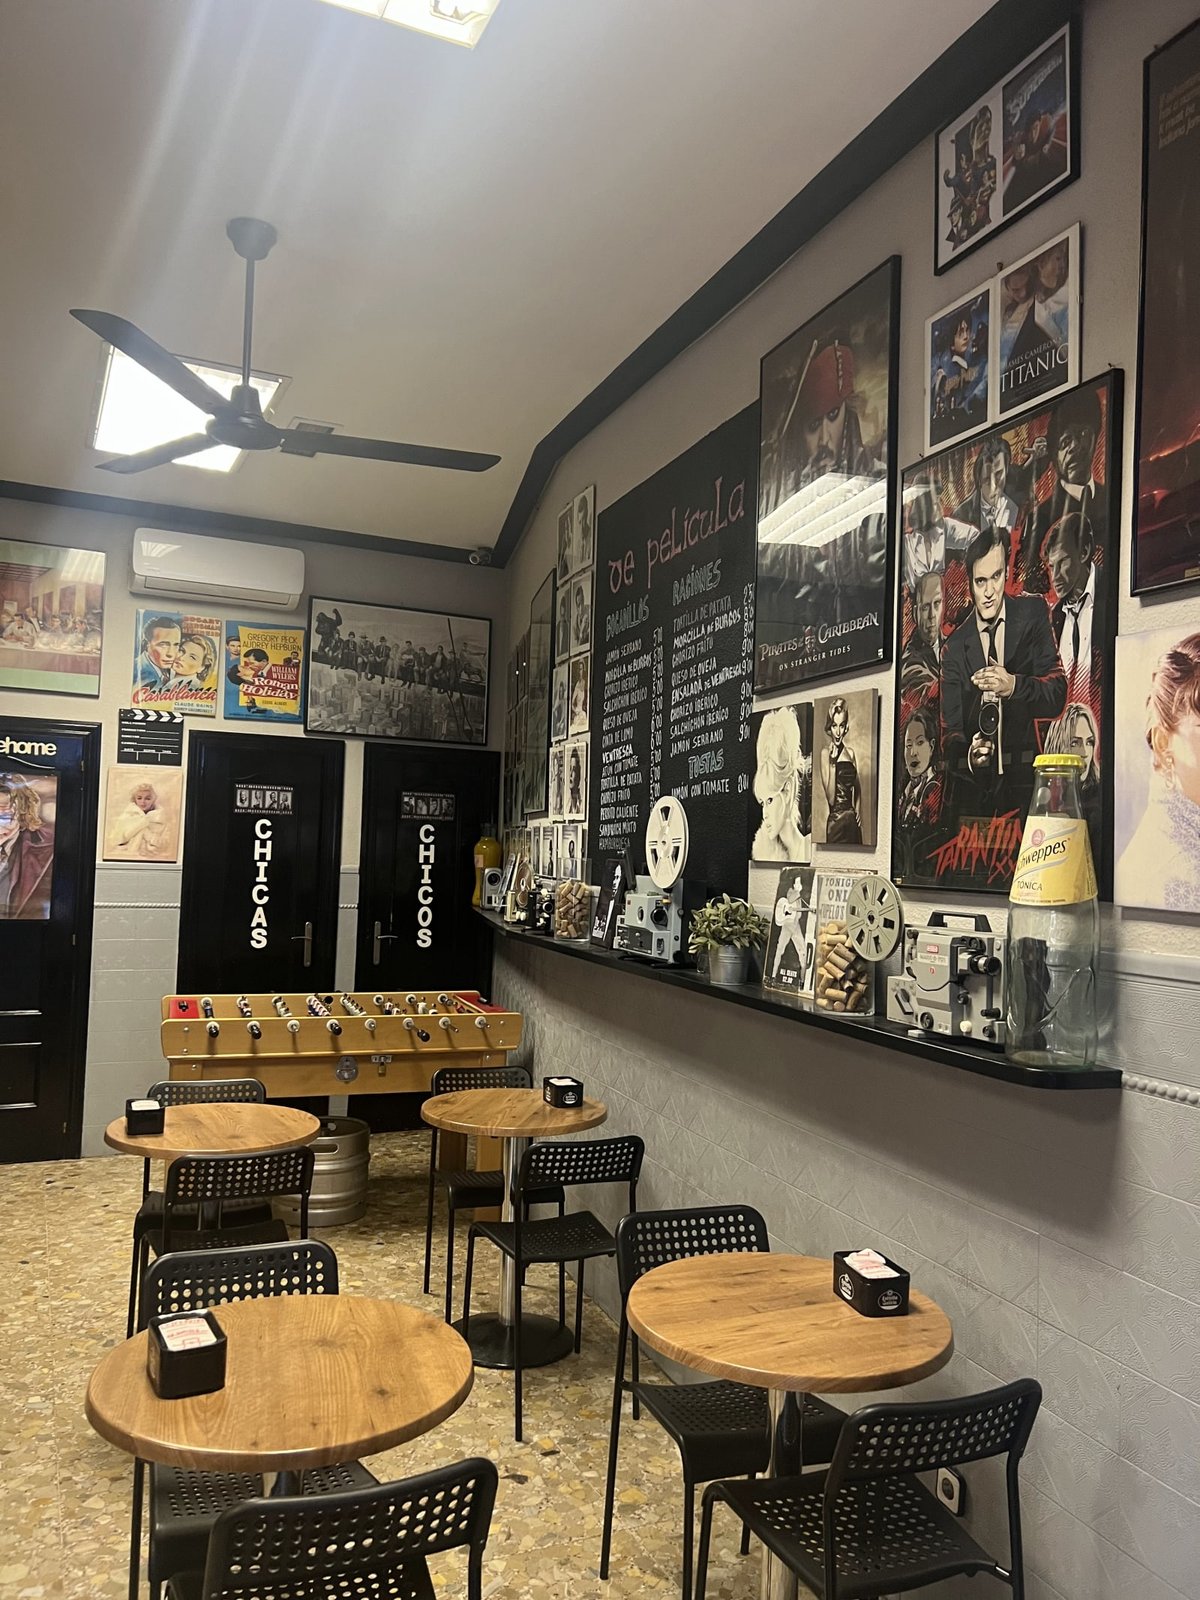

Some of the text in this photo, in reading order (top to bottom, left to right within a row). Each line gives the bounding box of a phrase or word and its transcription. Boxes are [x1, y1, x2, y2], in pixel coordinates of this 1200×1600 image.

[1000, 343, 1069, 392] TITANIC
[247, 633, 298, 643] GREGORY PECK
[818, 612, 879, 644] CARIBBEAN
[242, 641, 302, 652] AUDREY HEPBURN
[779, 644, 851, 671] ON STRANGER TIDES
[271, 665, 297, 674] WILLIAM
[132, 682, 217, 704] Casablanca
[925, 808, 1023, 881] TARANTIN
[250, 819, 273, 949] CHICAS
[416, 824, 435, 948] CHICOS
[828, 889, 848, 902] ONL
